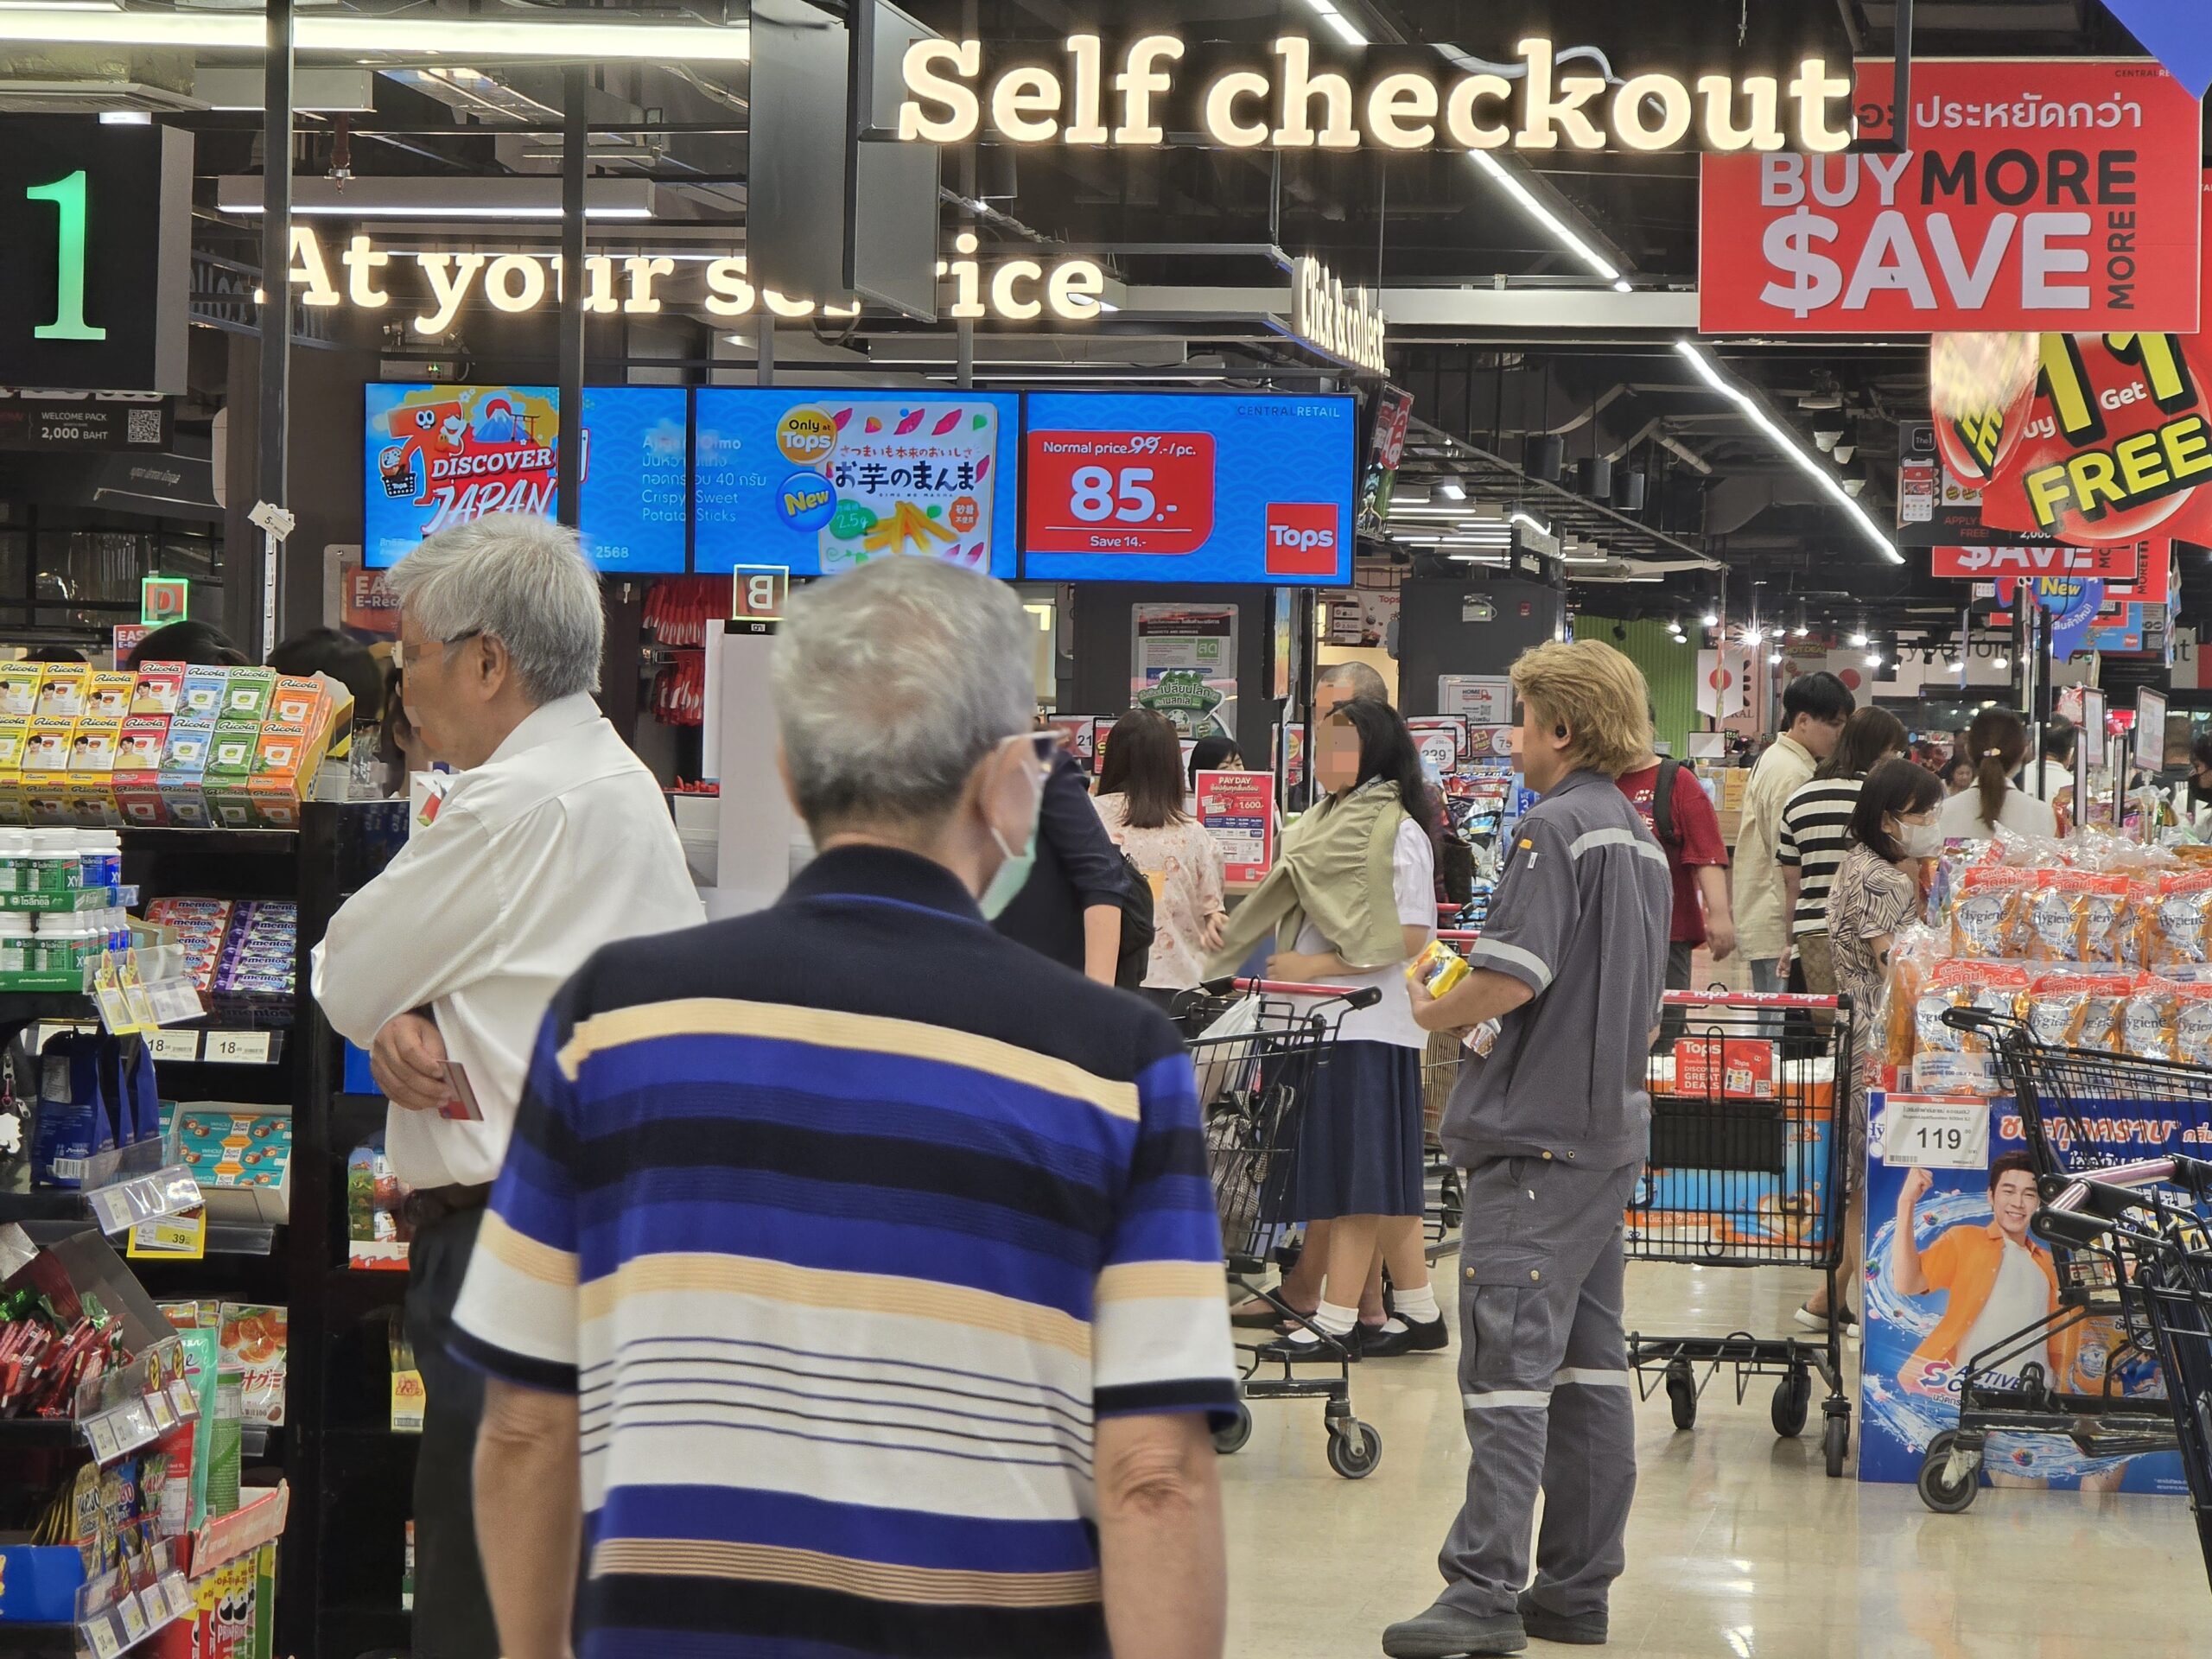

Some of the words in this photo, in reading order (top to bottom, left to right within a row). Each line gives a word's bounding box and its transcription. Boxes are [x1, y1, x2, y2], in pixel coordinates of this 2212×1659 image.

[2114, 69, 2171, 78] CENTRALRE
[898, 34, 1185, 145] Self
[1206, 37, 1858, 151] checkout
[1916, 92, 2143, 130] ประหยัดกว่า
[1761, 150, 1914, 207] BUY
[1920, 149, 2138, 207] MORE
[27, 169, 106, 340] 1
[2107, 211, 2136, 310] MORE
[1759, 206, 2092, 319] $AVE
[254, 226, 388, 308] At
[414, 253, 674, 335] your
[704, 233, 1105, 320] sice
[1301, 257, 1334, 352] Click
[1347, 286, 1385, 373] collect
[2100, 380, 2149, 411] Get
[41, 412, 84, 421] WELCOME
[85, 413, 107, 422] PACK
[1236, 405, 1340, 418] CENTRALRETAIL
[788, 419, 821, 432] Only
[822, 423, 831, 431] at
[2023, 416, 2056, 439] uy
[41, 427, 79, 441] 2,000
[83, 431, 109, 440] BAHT
[781, 431, 832, 453] Tops
[840, 445, 973, 460] さつまいも本来のおいしさ
[1043, 442, 1092, 454] Normal
[1095, 442, 1128, 456] price
[431, 448, 553, 478] DISCOVER
[835, 460, 976, 494] お芋のまんま
[2027, 416, 2212, 526] FREE
[715, 473, 734, 486] 40
[739, 473, 767, 486] กรัม
[642, 489, 686, 506] Crispy
[696, 489, 739, 504] Sweet
[1069, 465, 1179, 523] 85.-
[420, 478, 556, 534] JAPAN
[783, 488, 830, 516] New
[642, 507, 686, 522] Potato
[696, 507, 737, 522] Sticks
[1090, 535, 1122, 547] Save
[1269, 524, 1334, 552] Tops
[595, 546, 630, 558] 2568
[2040, 575, 2082, 597] New
[1, 663, 39, 673] Ricola
[47, 664, 85, 674] Ricola
[141, 663, 181, 673] Ricola
[188, 667, 226, 677] Ricola
[232, 668, 270, 679] Ricola
[94, 673, 132, 683] Ricola
[280, 678, 319, 690] Ricola
[34, 716, 72, 727] Ricola
[79, 716, 118, 727] Ricola
[125, 717, 164, 728] Ricola
[173, 716, 211, 729] Ricola
[219, 720, 257, 731] Ricola
[264, 722, 303, 734] Ricola
[173, 918, 213, 927] mentos
[2033, 910, 2079, 926] Hygiene
[259, 921, 296, 930] mento
[251, 939, 293, 948] mentos
[247, 957, 288, 965] mentos
[243, 974, 283, 982] mentos
[148, 1039, 164, 1052] 18
[219, 1041, 237, 1054] 18
[1682, 1041, 1722, 1057] Tops
[1733, 1058, 1751, 1067] Tops
[1916, 1127, 1962, 1150] 119
[172, 1233, 186, 1244] 39
[1932, 1393, 1961, 1407] นวัตกร
